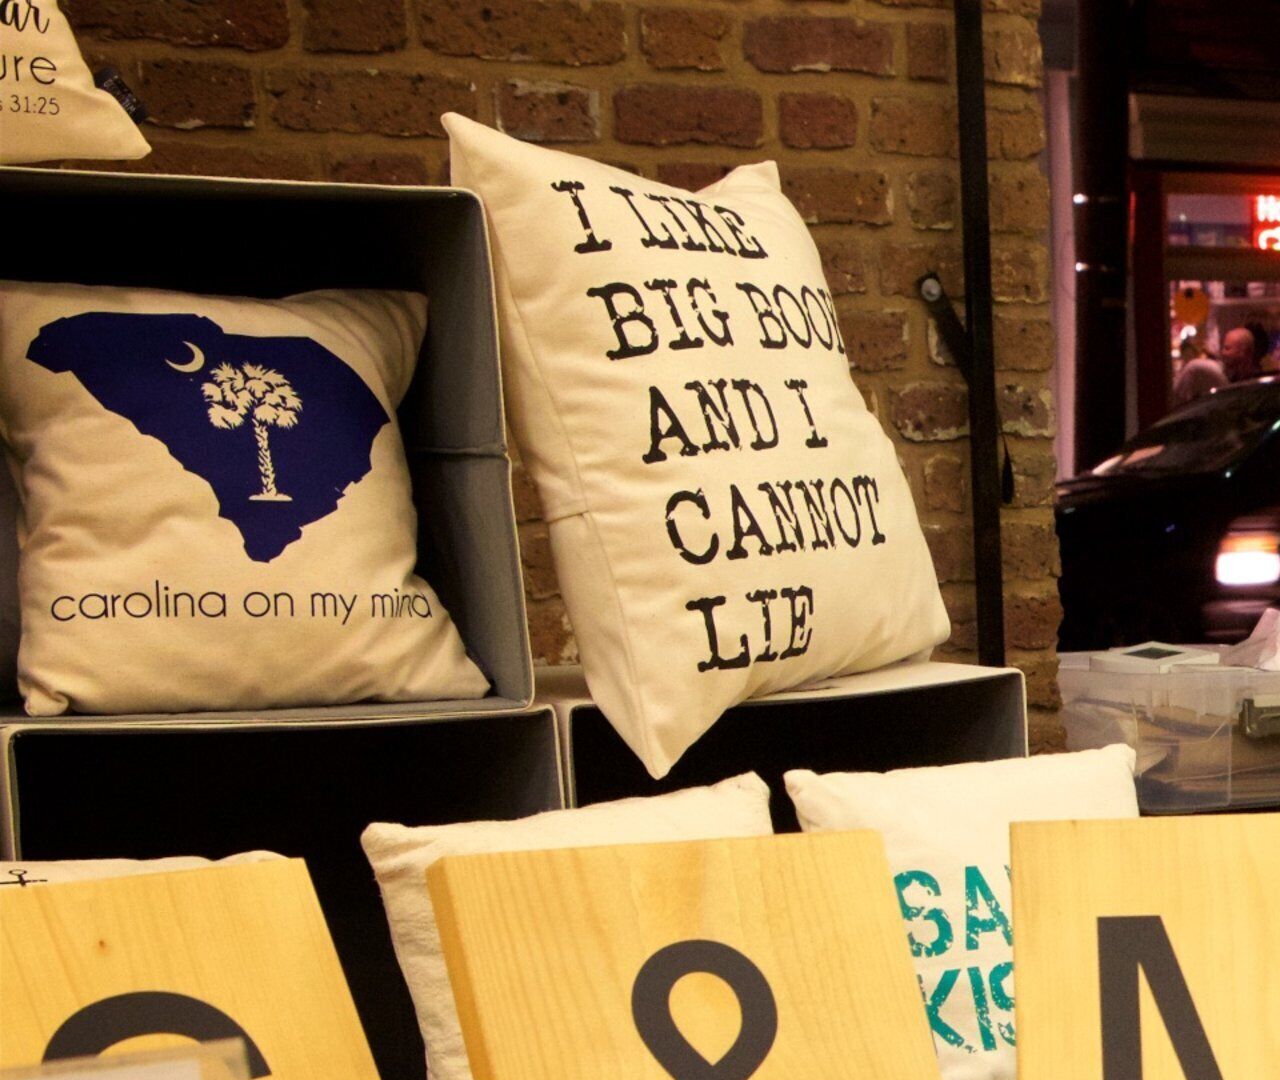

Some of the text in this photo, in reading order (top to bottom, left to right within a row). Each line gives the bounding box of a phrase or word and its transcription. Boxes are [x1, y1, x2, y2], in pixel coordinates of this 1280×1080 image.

[10, 94, 60, 116] 31:25
[550, 180, 768, 259] I LIKE
[586, 278, 734, 361] BIG
[642, 378, 829, 464] AND I
[665, 474, 886, 565] CANNOT
[51, 579, 227, 622] carolina
[243, 590, 296, 618] on
[310, 592, 358, 625] my
[685, 585, 813, 673] LIE
